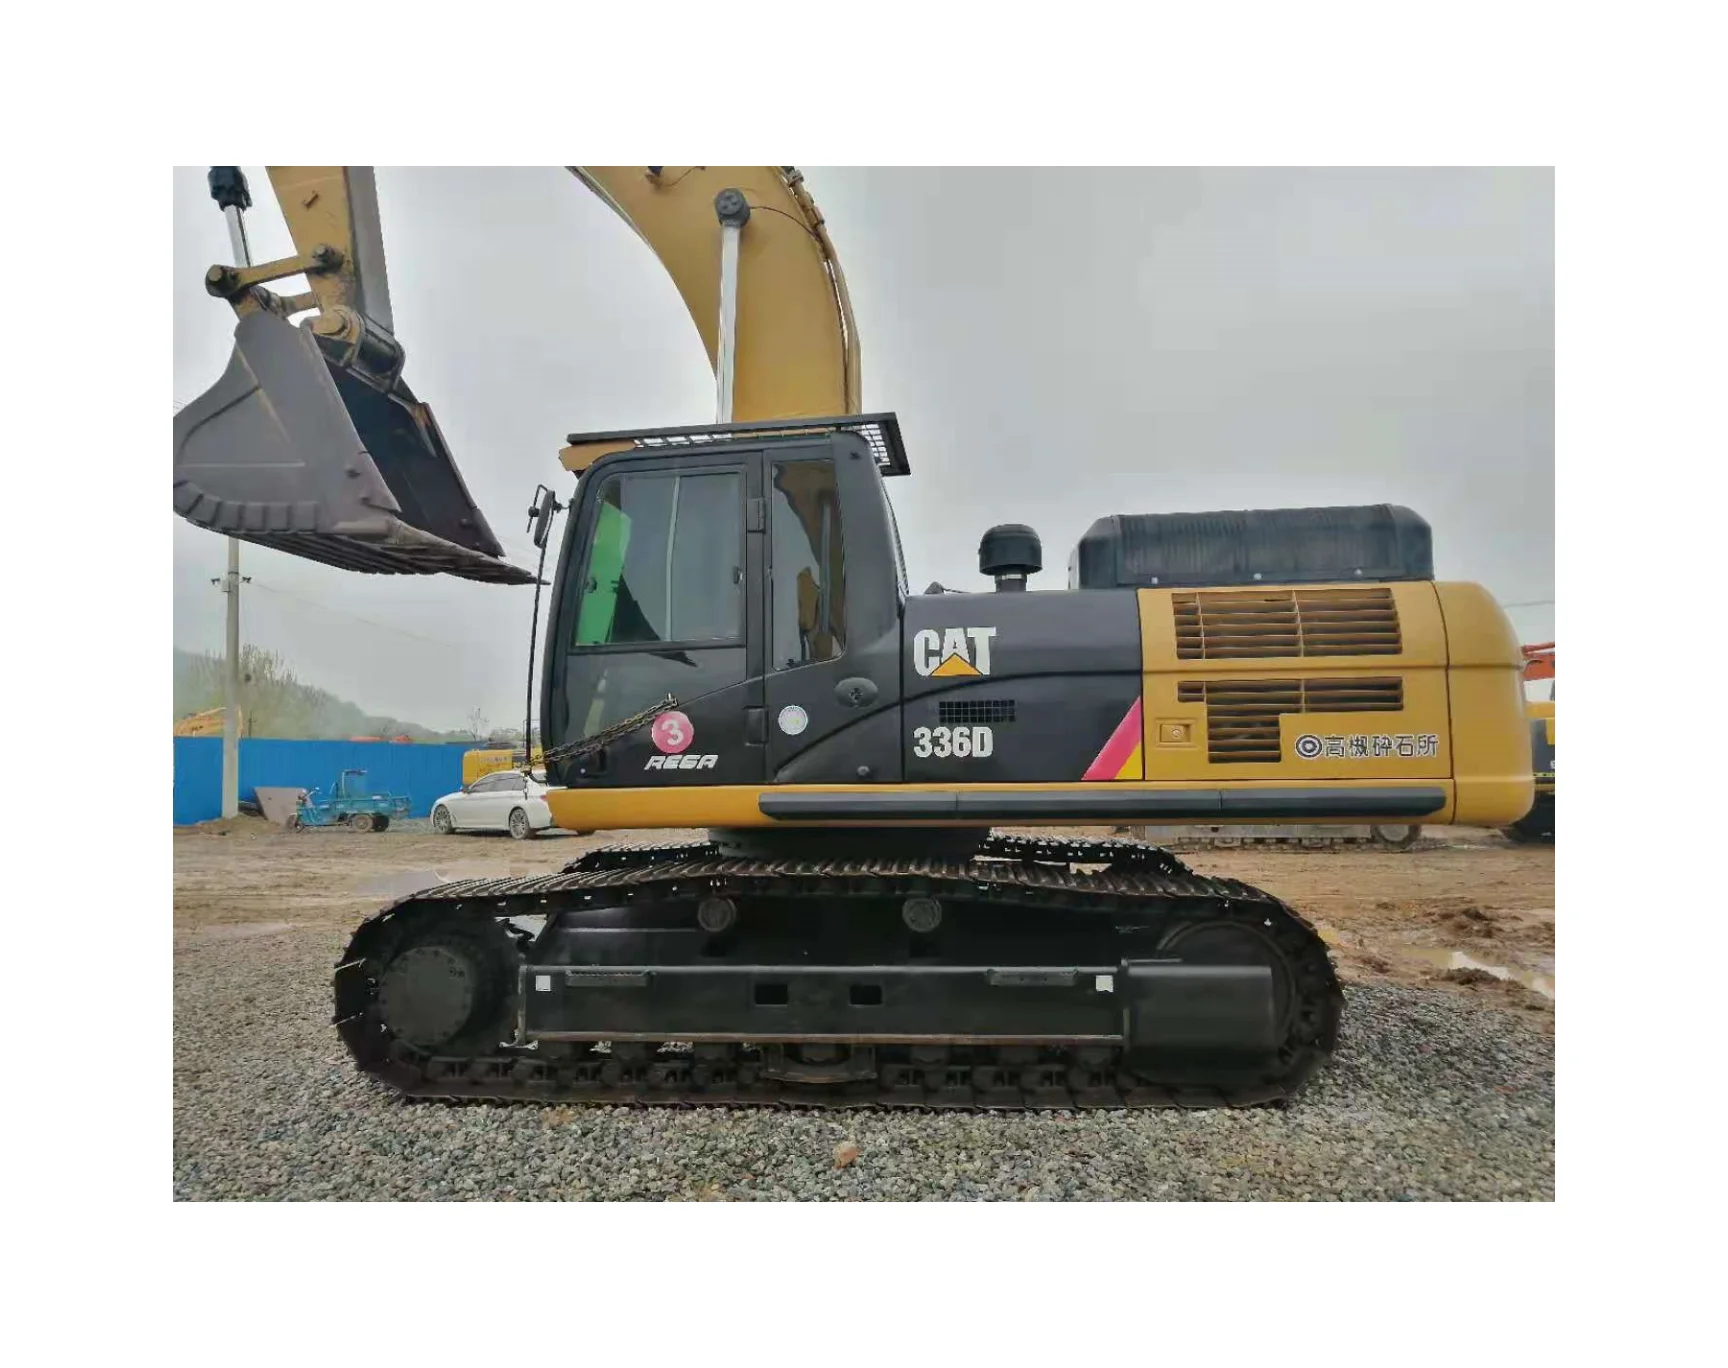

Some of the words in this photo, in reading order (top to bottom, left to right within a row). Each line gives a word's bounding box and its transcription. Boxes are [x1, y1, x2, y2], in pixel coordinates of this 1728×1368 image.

[913, 627, 997, 676] CAT
[662, 719, 685, 746] 3
[913, 726, 994, 758] 336D
